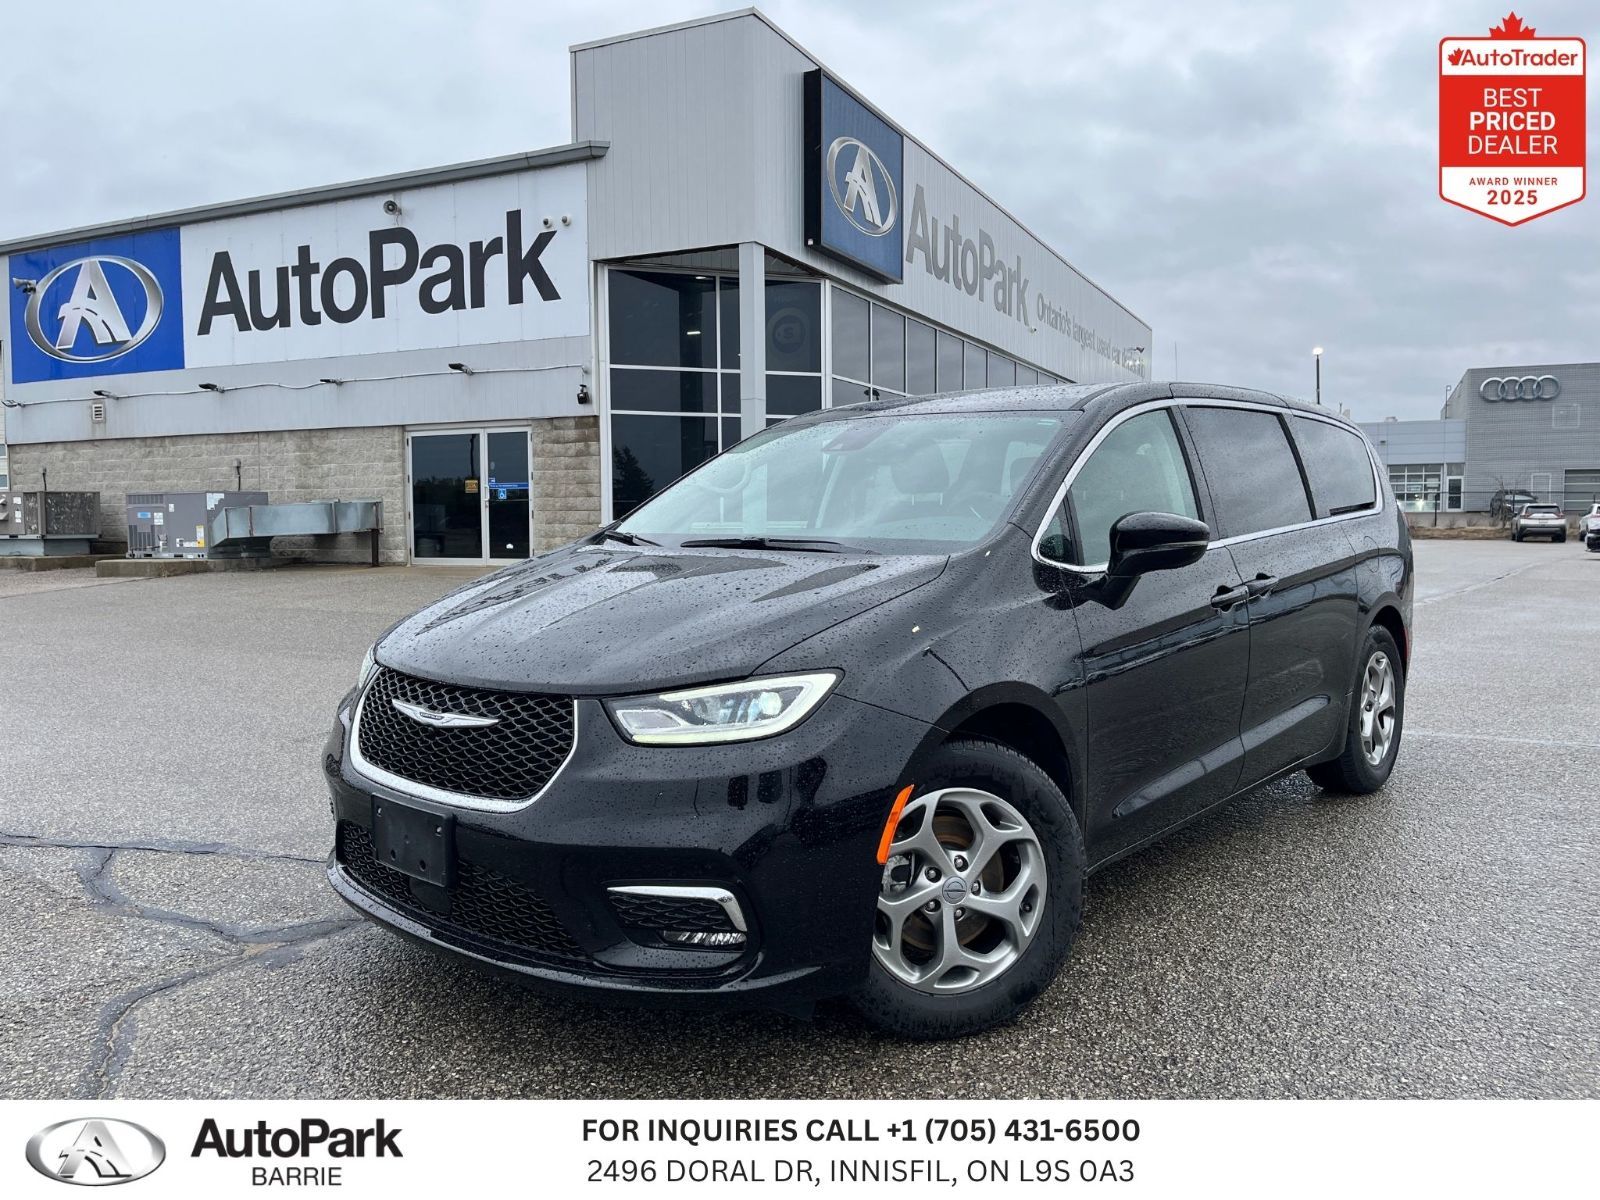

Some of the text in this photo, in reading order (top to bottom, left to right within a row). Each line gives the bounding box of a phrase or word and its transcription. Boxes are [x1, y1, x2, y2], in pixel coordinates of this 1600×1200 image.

[197, 208, 562, 336] AutoPark
[905, 183, 1030, 327] AutoPark
[1037, 292, 1072, 338] Ontario's
[1072, 315, 1096, 352] largest
